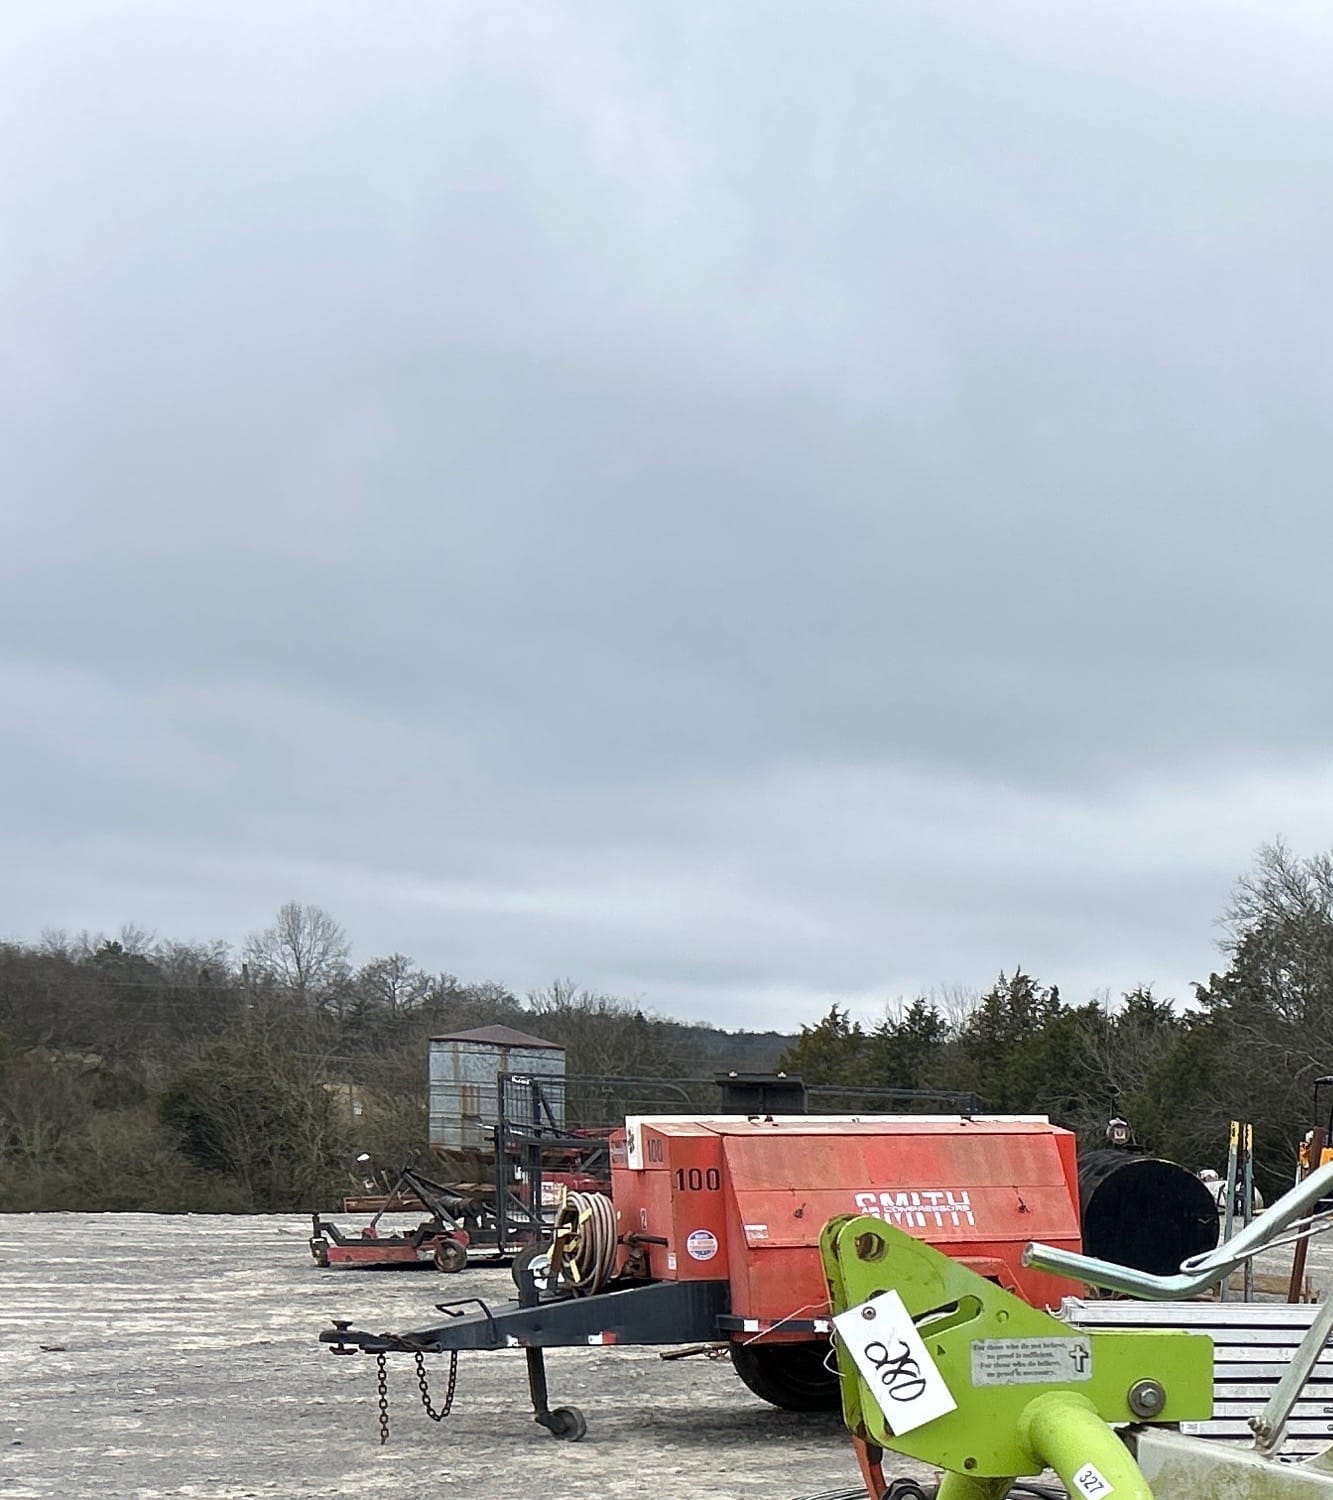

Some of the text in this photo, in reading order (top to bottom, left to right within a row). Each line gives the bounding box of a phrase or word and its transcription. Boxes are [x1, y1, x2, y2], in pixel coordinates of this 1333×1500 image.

[675, 1168, 720, 1192] 100
[855, 1191, 976, 1227] SMITH
[864, 1339, 927, 1402] 280
[1079, 1470, 1105, 1493] 327
